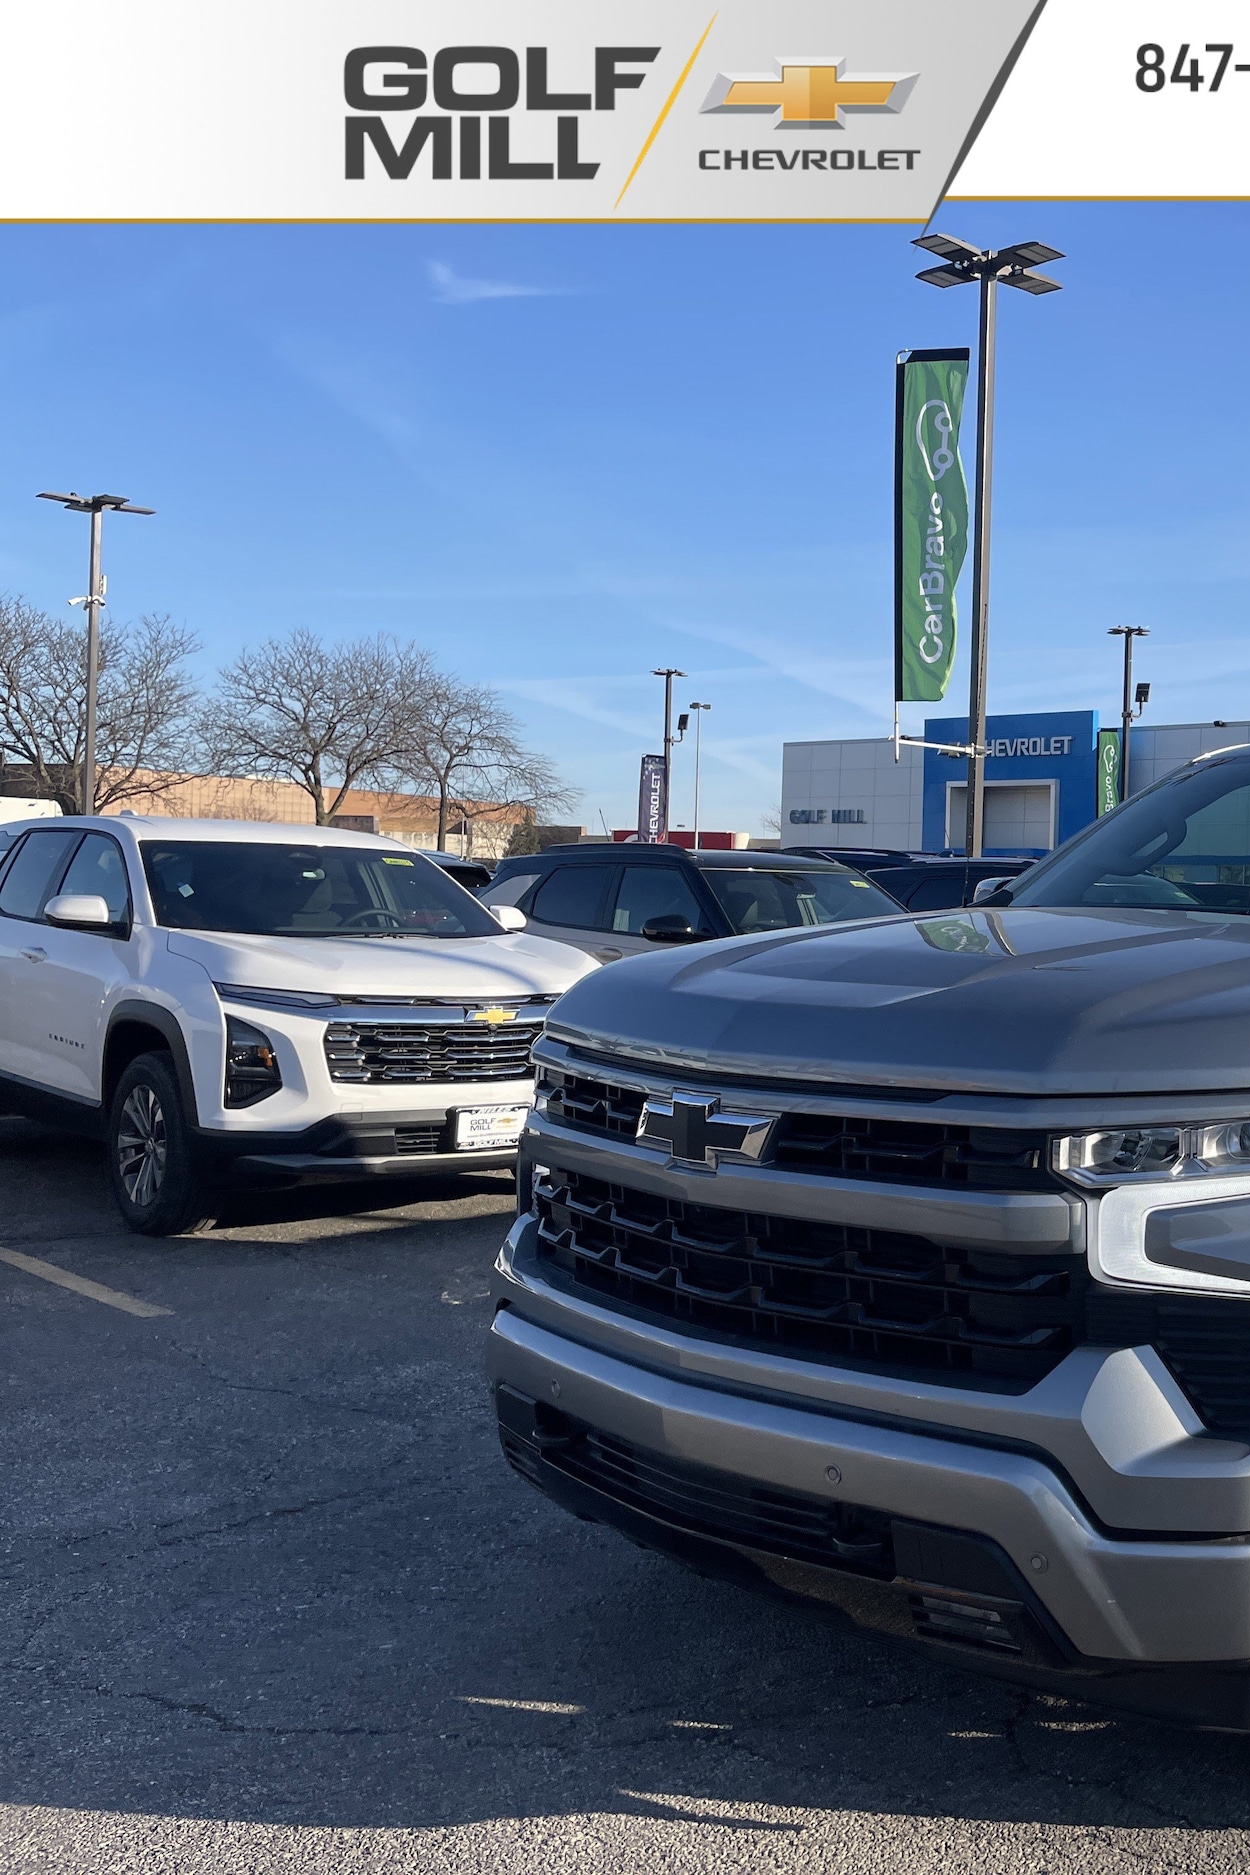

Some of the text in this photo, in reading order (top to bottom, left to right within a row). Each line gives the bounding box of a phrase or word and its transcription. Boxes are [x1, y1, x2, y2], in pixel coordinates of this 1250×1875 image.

[918, 491, 945, 664] CarBravo
[984, 735, 1072, 757] HEVROLET
[789, 809, 868, 825] GOLF MILL
